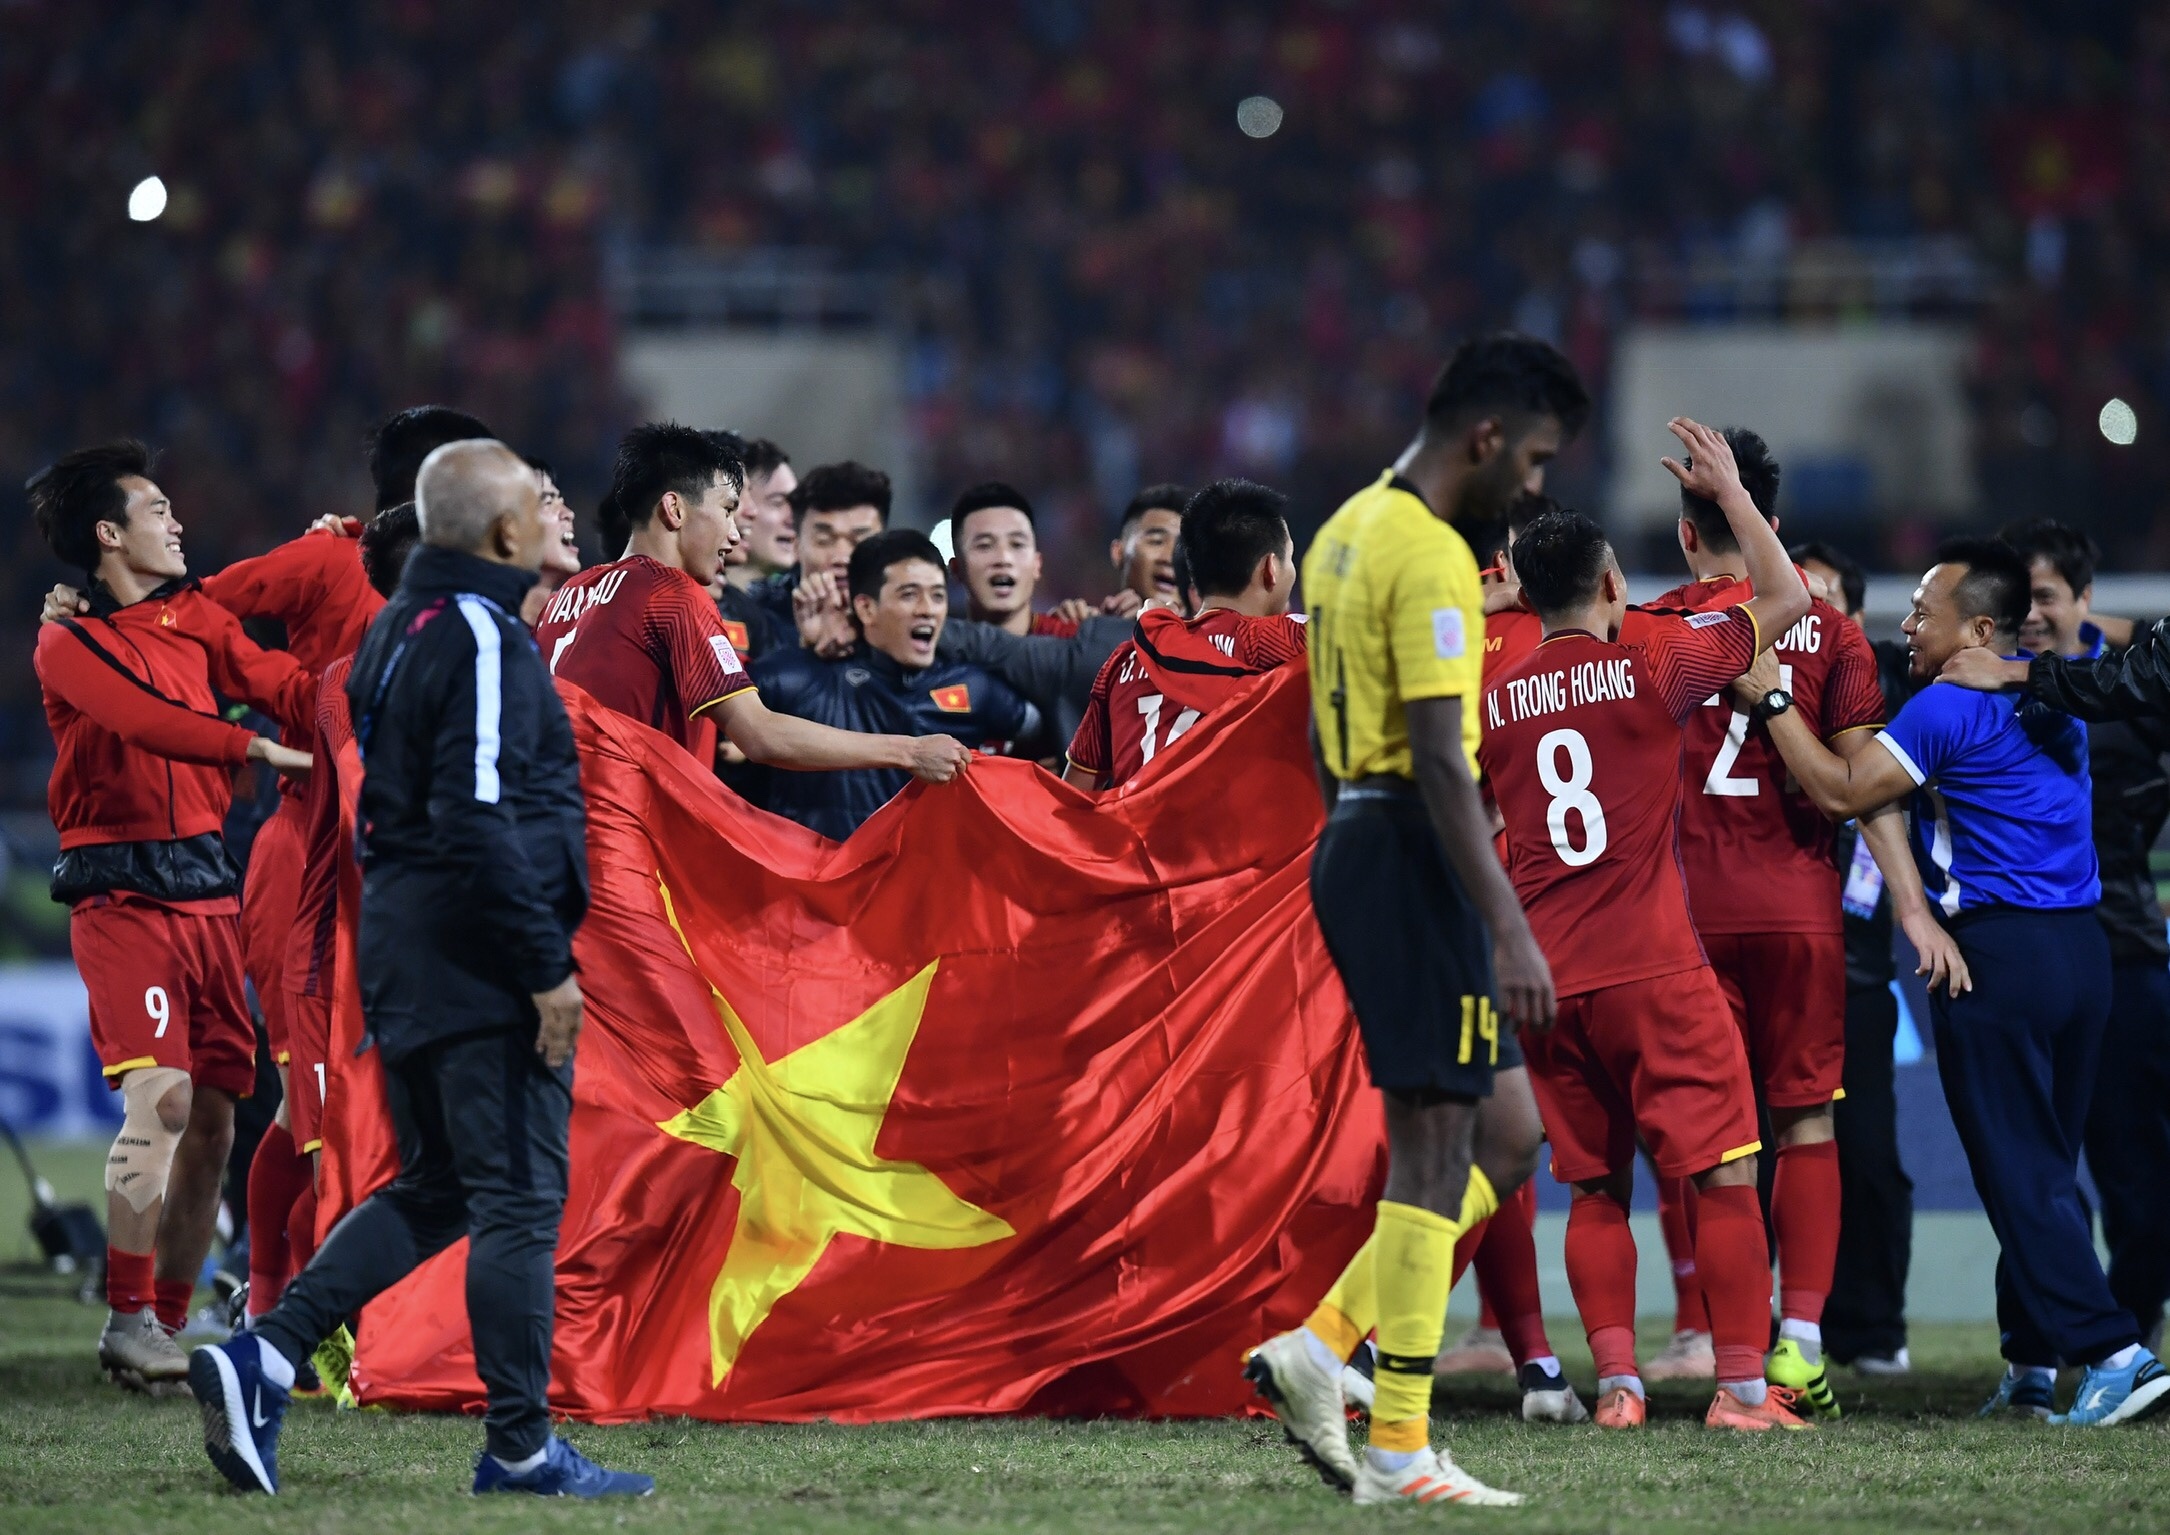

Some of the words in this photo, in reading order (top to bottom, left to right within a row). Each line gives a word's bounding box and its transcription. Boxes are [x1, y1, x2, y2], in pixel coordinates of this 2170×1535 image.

[1487, 689, 1506, 730] N.
[1507, 670, 1566, 722] TRONG
[1570, 658, 1636, 707] HOANG
[1536, 728, 1608, 867] 8
[144, 985, 170, 1039] 9
[1457, 994, 1499, 1067] 14
